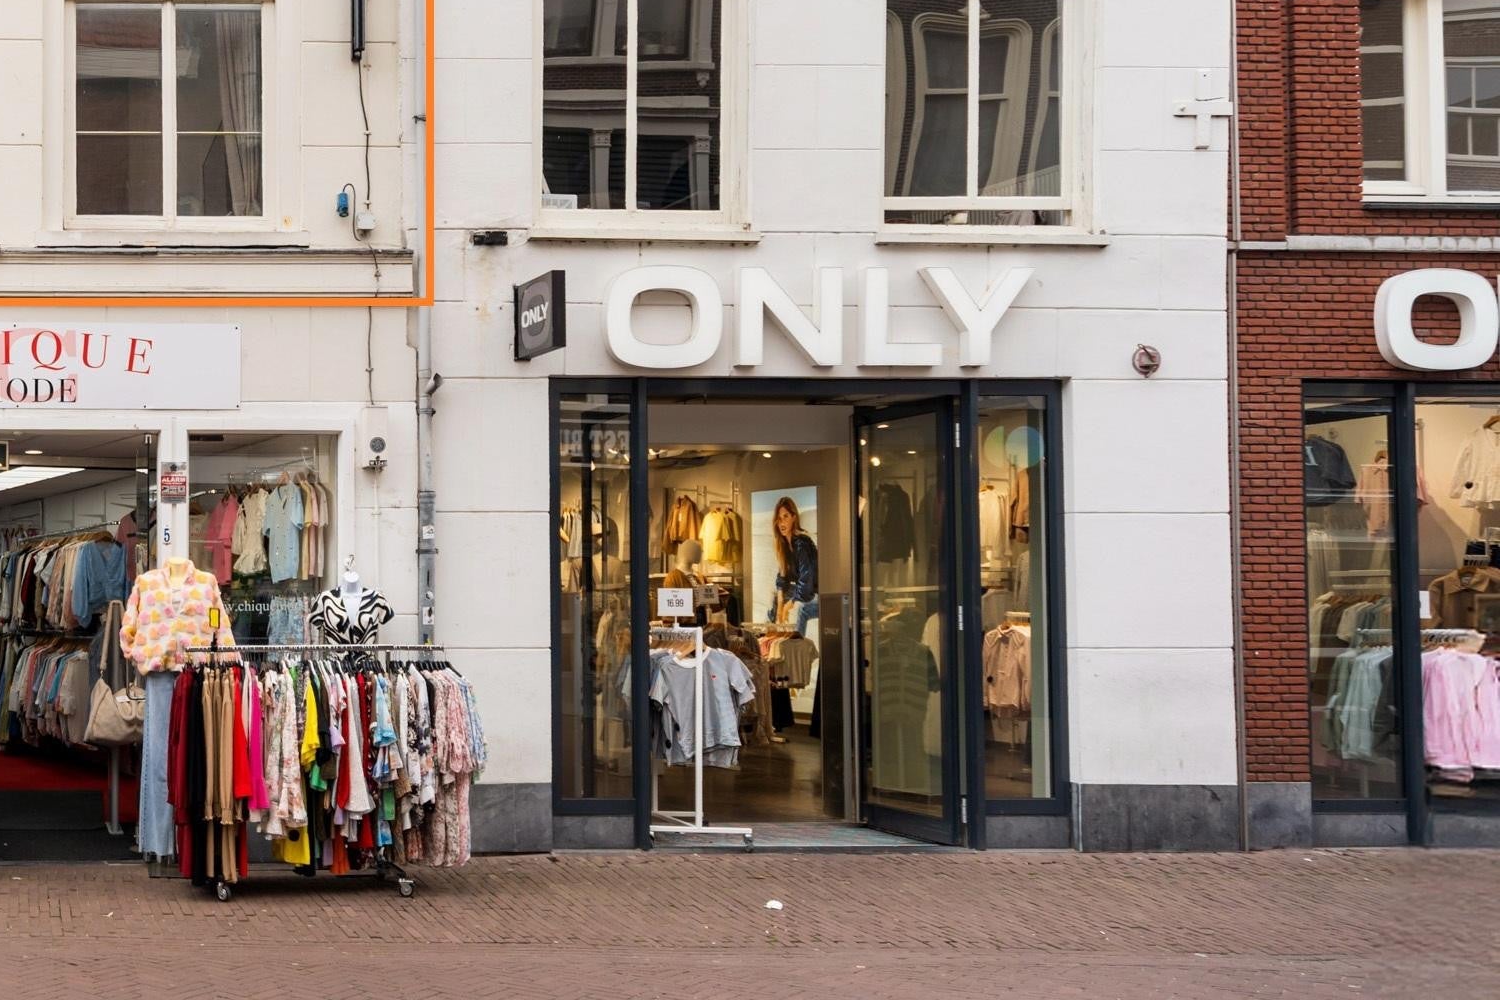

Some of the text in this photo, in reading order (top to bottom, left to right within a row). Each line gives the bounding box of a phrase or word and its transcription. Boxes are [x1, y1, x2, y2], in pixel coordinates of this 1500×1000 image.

[521, 301, 549, 329] ONLY
[605, 265, 1036, 369] ONLY
[1374, 267, 1500, 371] O
[164, 528, 171, 543] 5
[667, 598, 684, 608] 16.99
